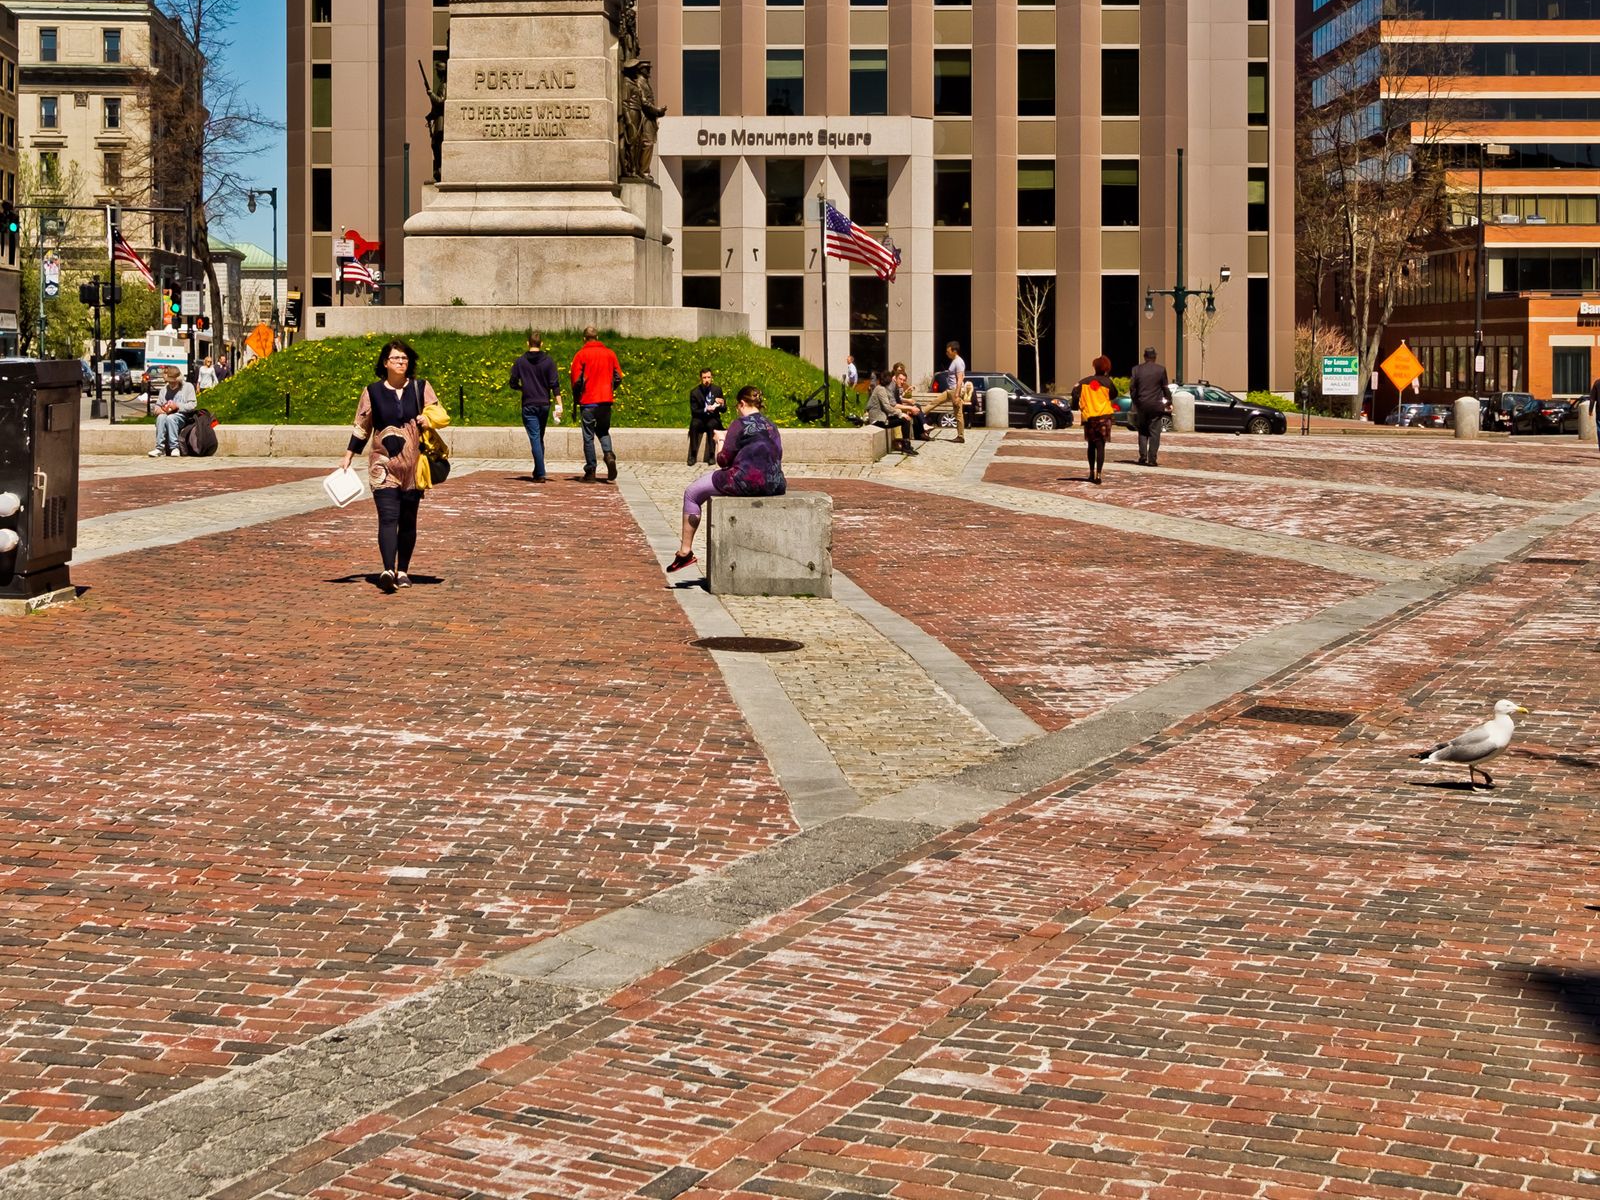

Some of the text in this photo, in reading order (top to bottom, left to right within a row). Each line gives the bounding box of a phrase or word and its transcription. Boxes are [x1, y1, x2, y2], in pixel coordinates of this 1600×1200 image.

[474, 71, 576, 90] PORTLAND
[461, 106, 590, 120] TO HER SONS WHO DIED
[483, 123, 567, 137] FOR THE UNION
[697, 129, 872, 149] One Monument Square
